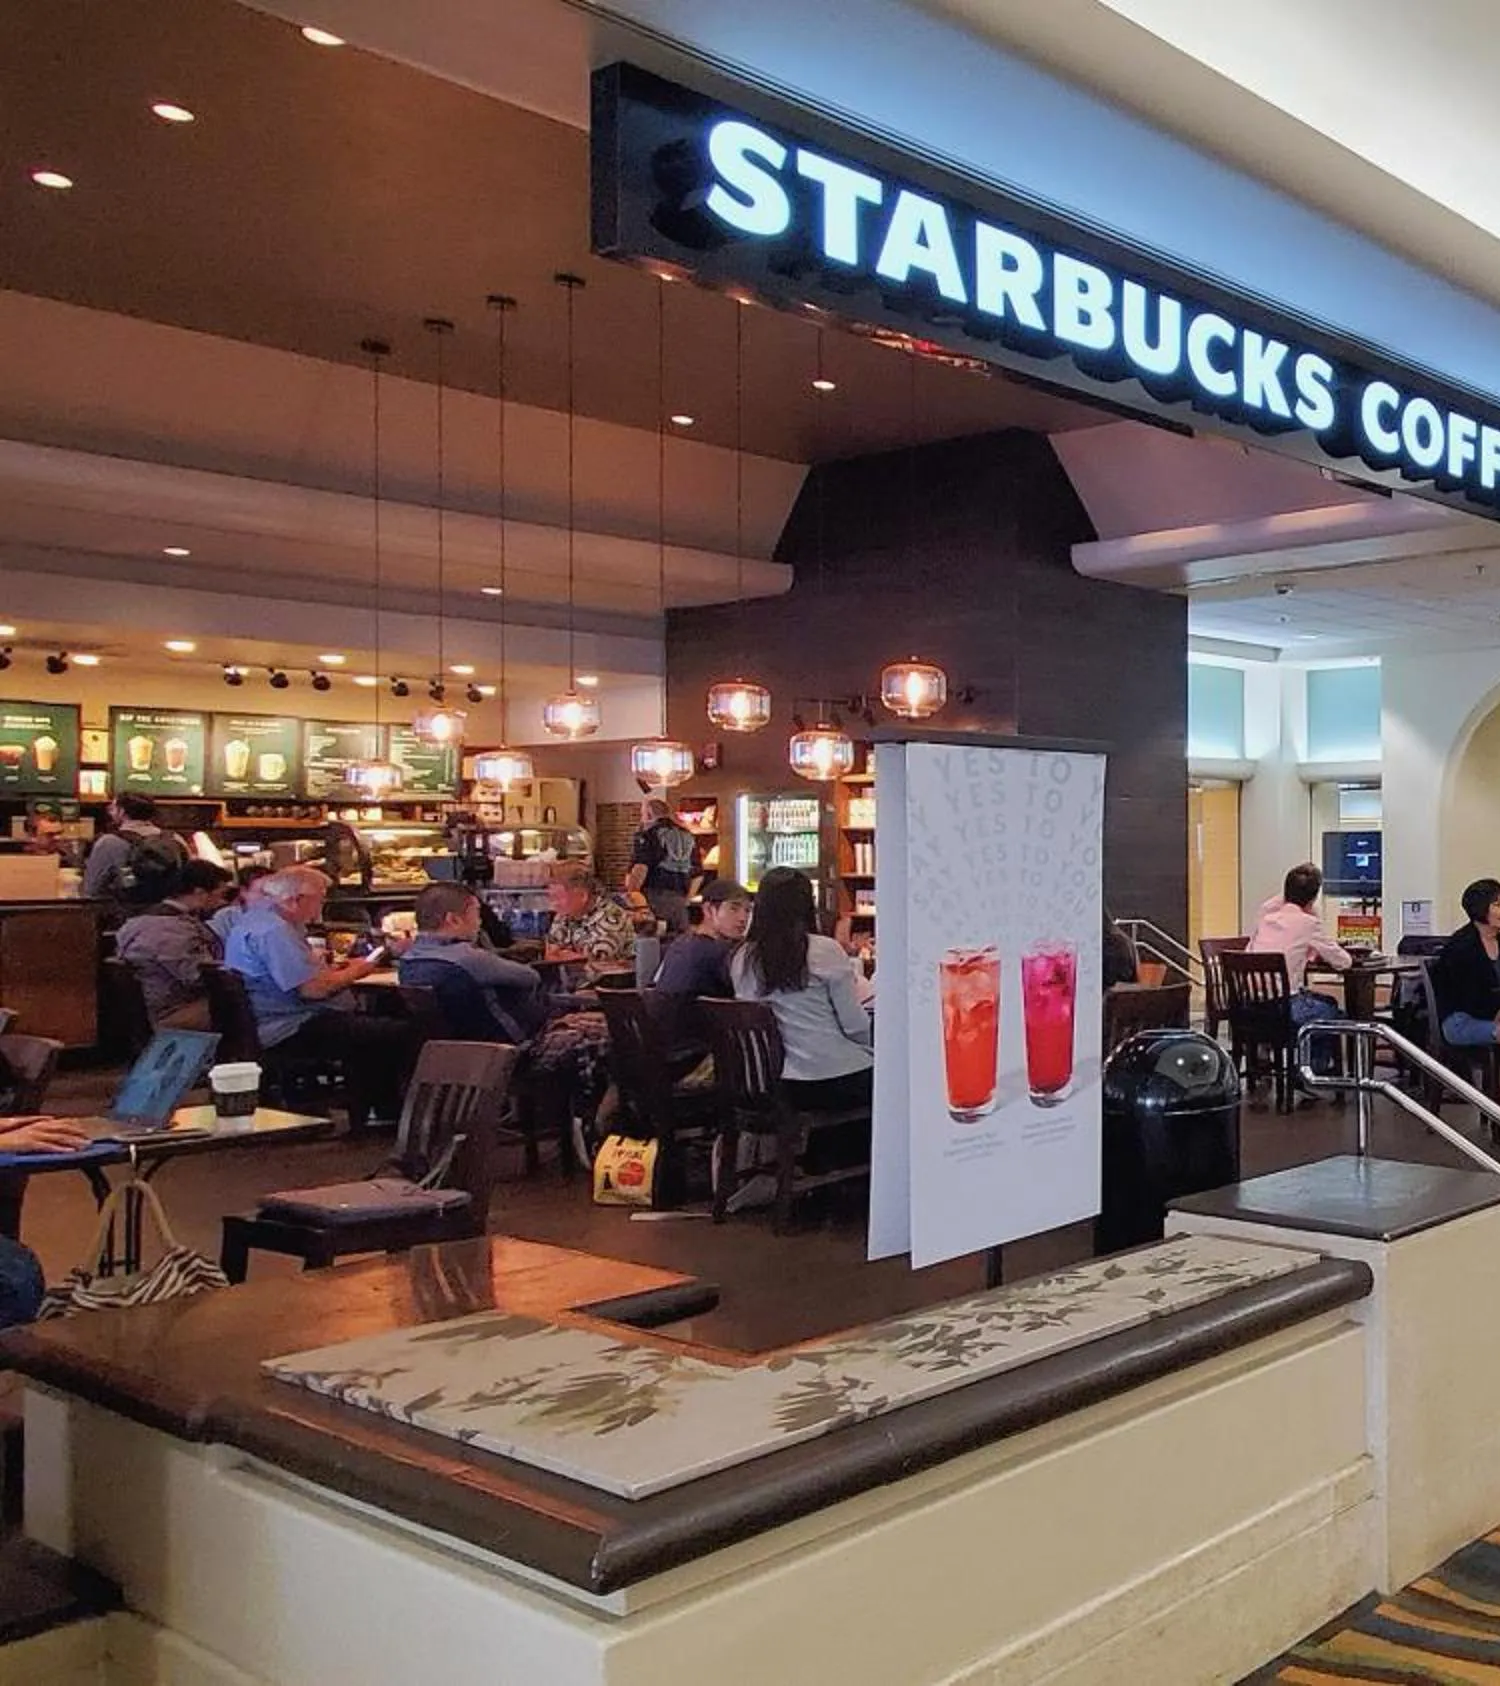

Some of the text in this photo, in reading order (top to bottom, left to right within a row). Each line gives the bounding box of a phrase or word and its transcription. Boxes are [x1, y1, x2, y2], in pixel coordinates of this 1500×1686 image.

[704, 119, 1337, 433] STARBUCKS
[932, 749, 1006, 784] YES
[945, 780, 1007, 815] YES
[1026, 782, 1064, 814] TO
[953, 812, 1008, 843] YES
[1023, 814, 1055, 840] TO
[1020, 843, 1050, 866] TO
